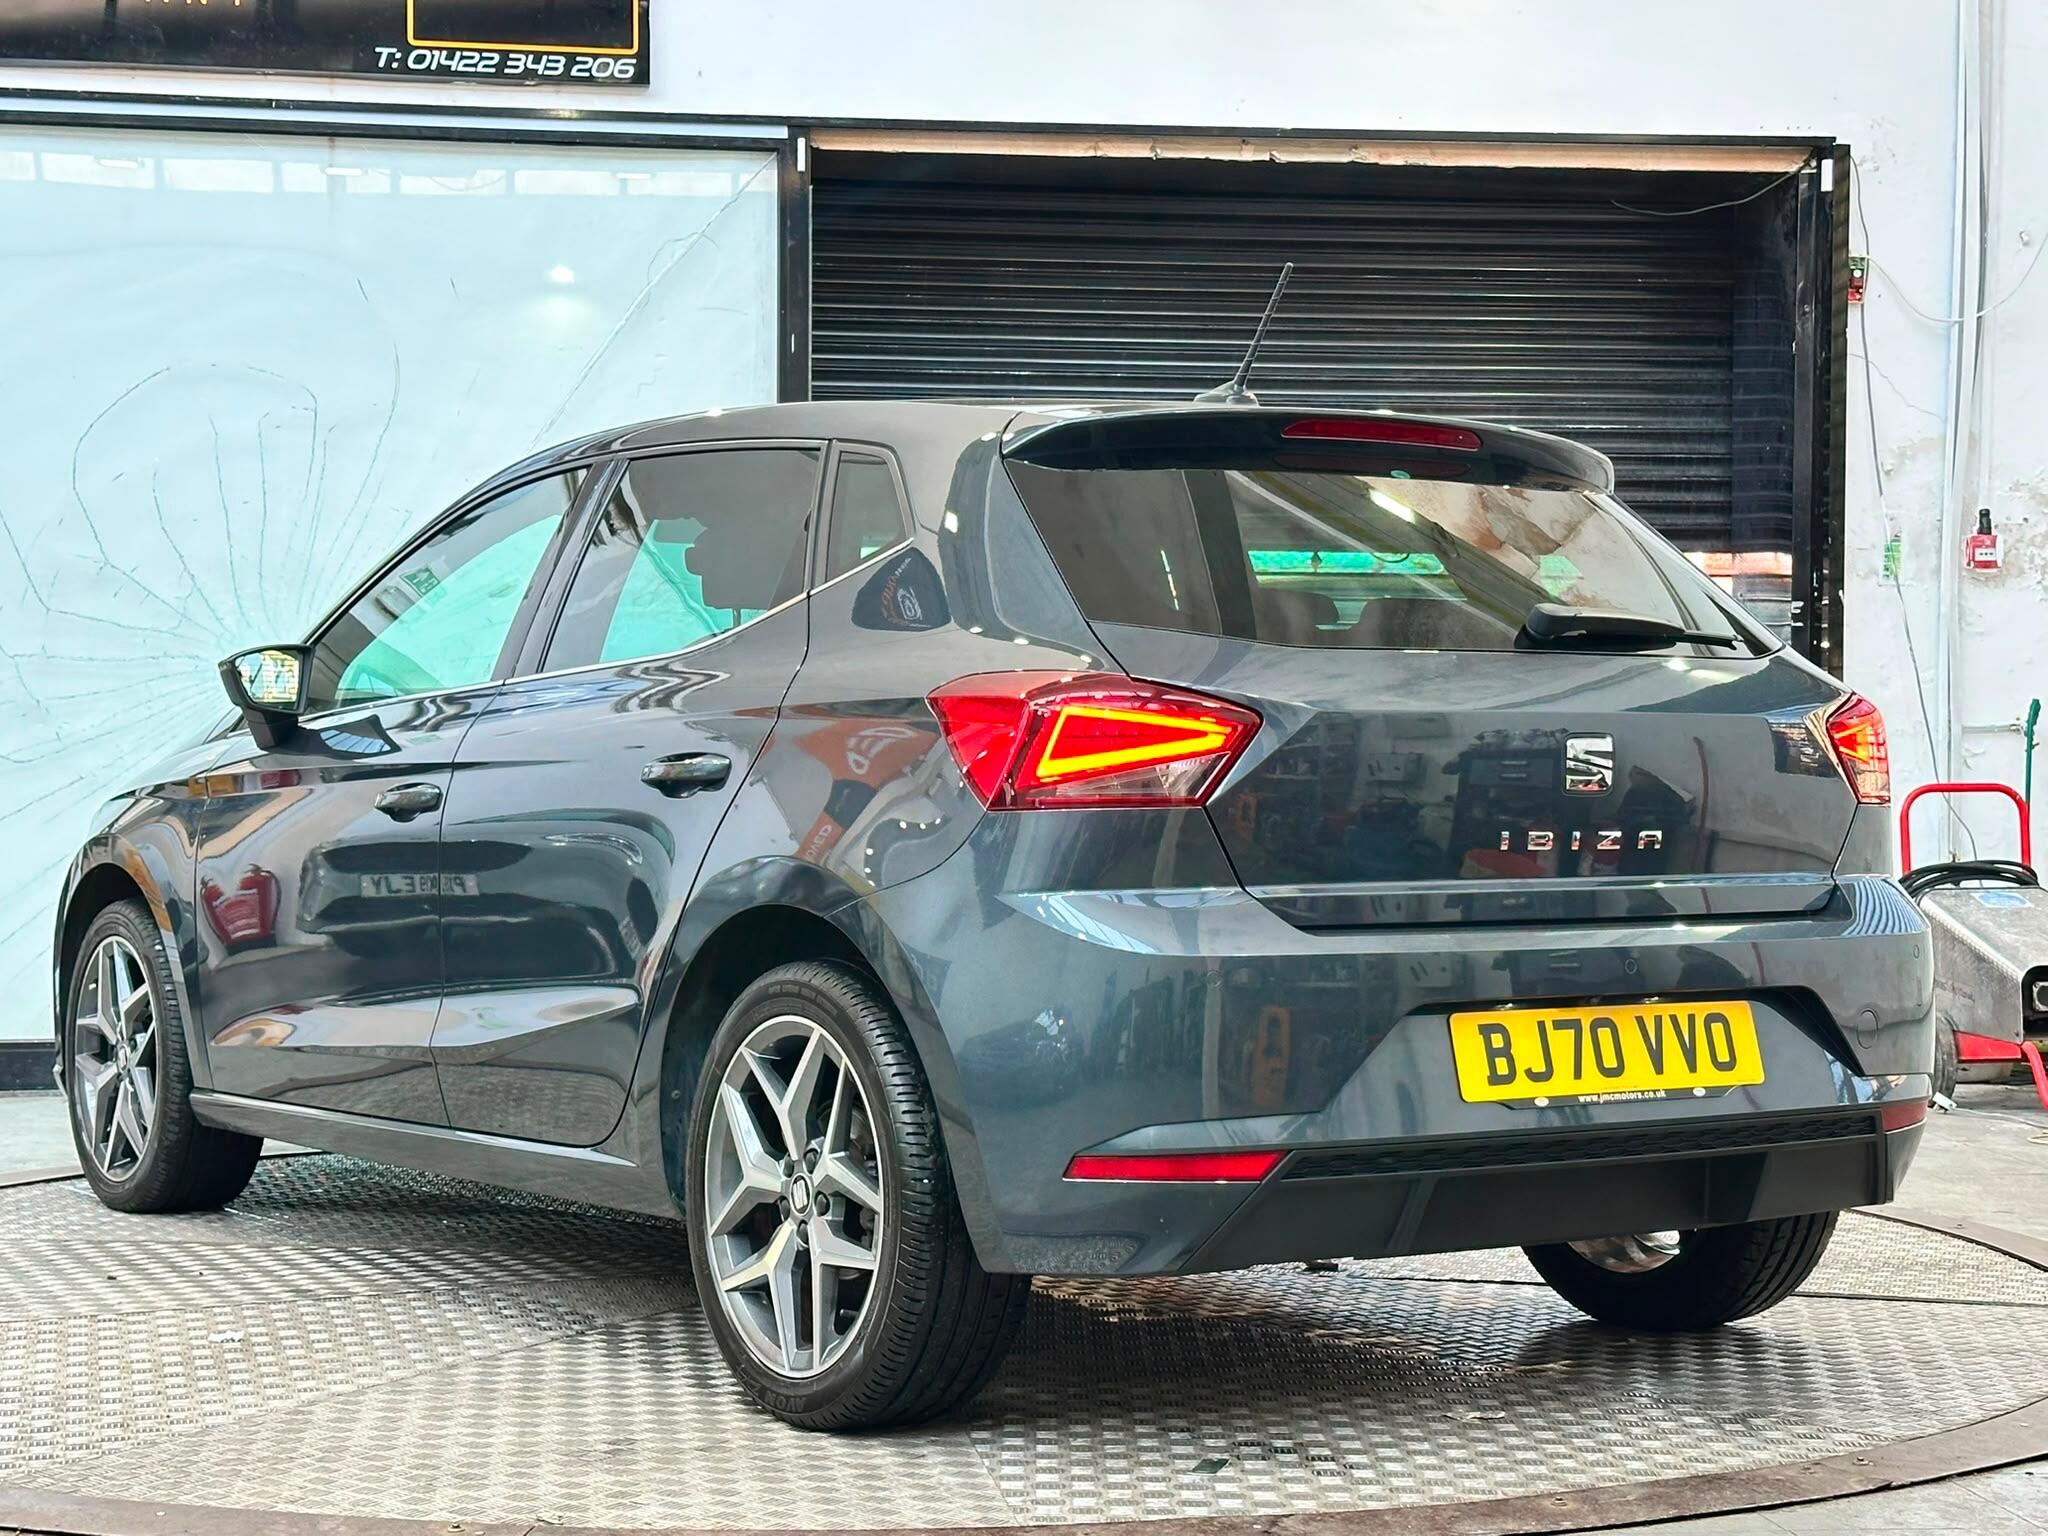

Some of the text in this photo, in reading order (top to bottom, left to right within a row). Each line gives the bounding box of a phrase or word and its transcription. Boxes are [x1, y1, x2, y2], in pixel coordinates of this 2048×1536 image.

[374, 47, 637, 79] T: 01422 343 206
[1500, 831, 1663, 851] IBIZA
[1478, 1012, 1737, 1086] BJ70 VVO
[1577, 1089, 1667, 1104] www.jmcmotors.co.uk
